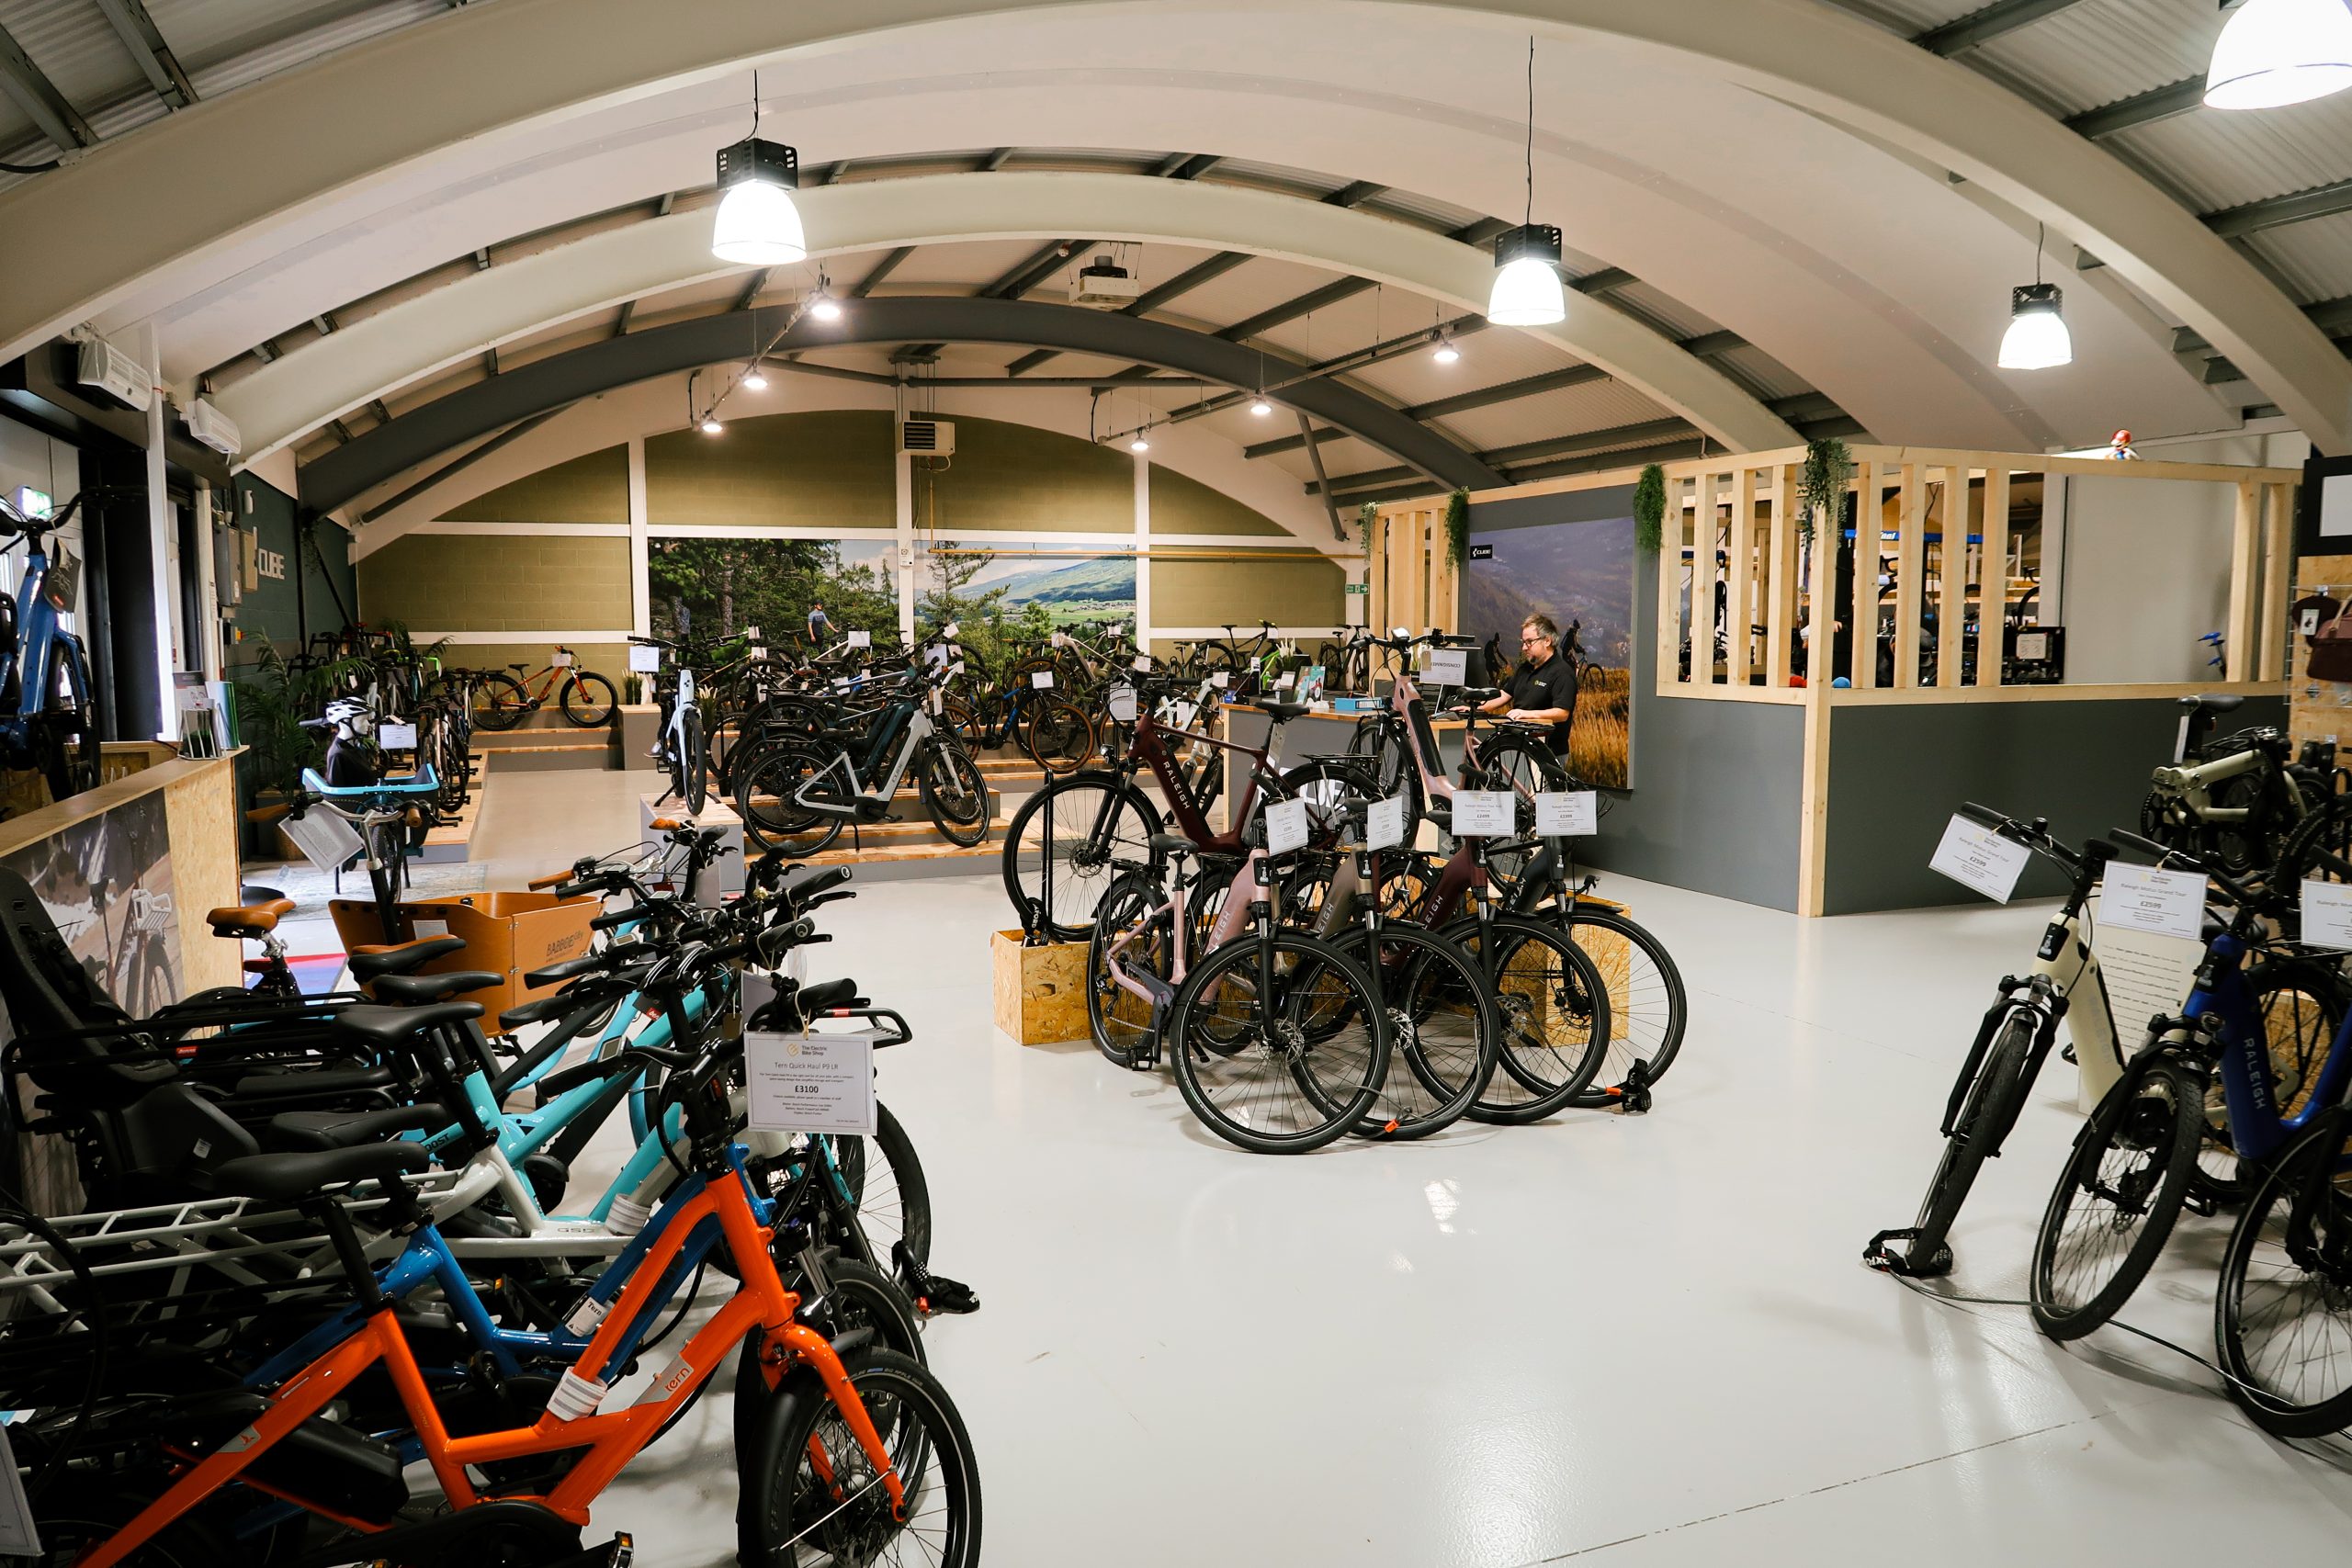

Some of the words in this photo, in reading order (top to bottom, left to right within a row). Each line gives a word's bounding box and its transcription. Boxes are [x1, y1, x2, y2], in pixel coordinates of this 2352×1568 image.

[1163, 761, 1191, 809] RALEIGH
[547, 934, 574, 957] BABBOE
[2243, 1037, 2267, 1110] RALEIGH
[795, 1085, 819, 1093] £3100
[424, 1133, 451, 1152] OOST
[587, 1301, 603, 1316] Tern
[664, 1367, 690, 1393] tern
